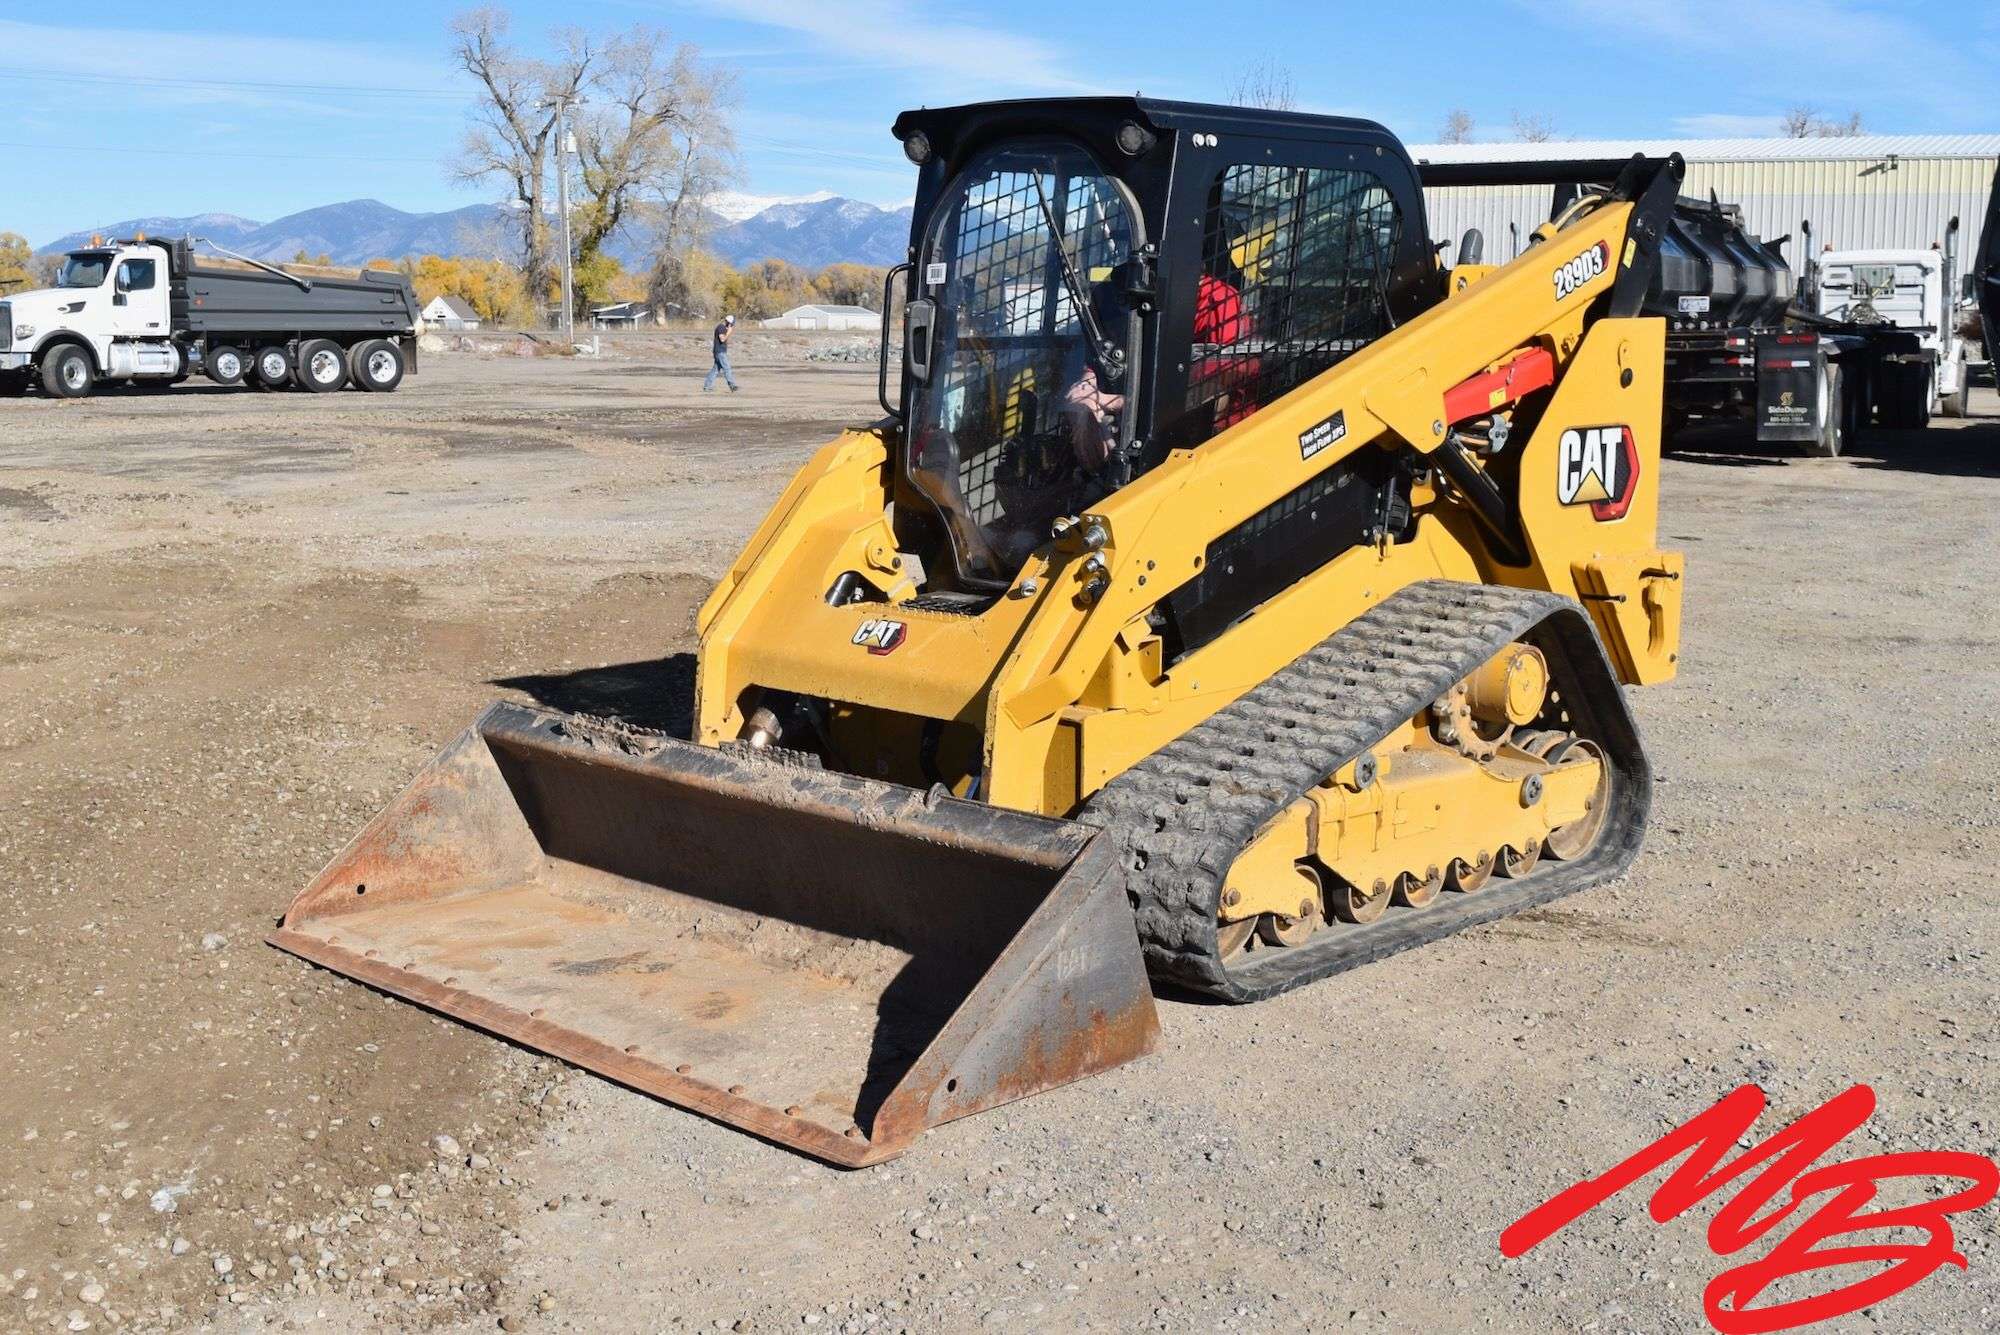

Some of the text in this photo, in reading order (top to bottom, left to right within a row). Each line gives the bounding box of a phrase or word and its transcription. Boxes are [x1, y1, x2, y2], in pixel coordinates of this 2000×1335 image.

[1553, 244, 1603, 300] 289D3
[1559, 427, 1622, 504] CAT
[852, 620, 902, 648] CAT
